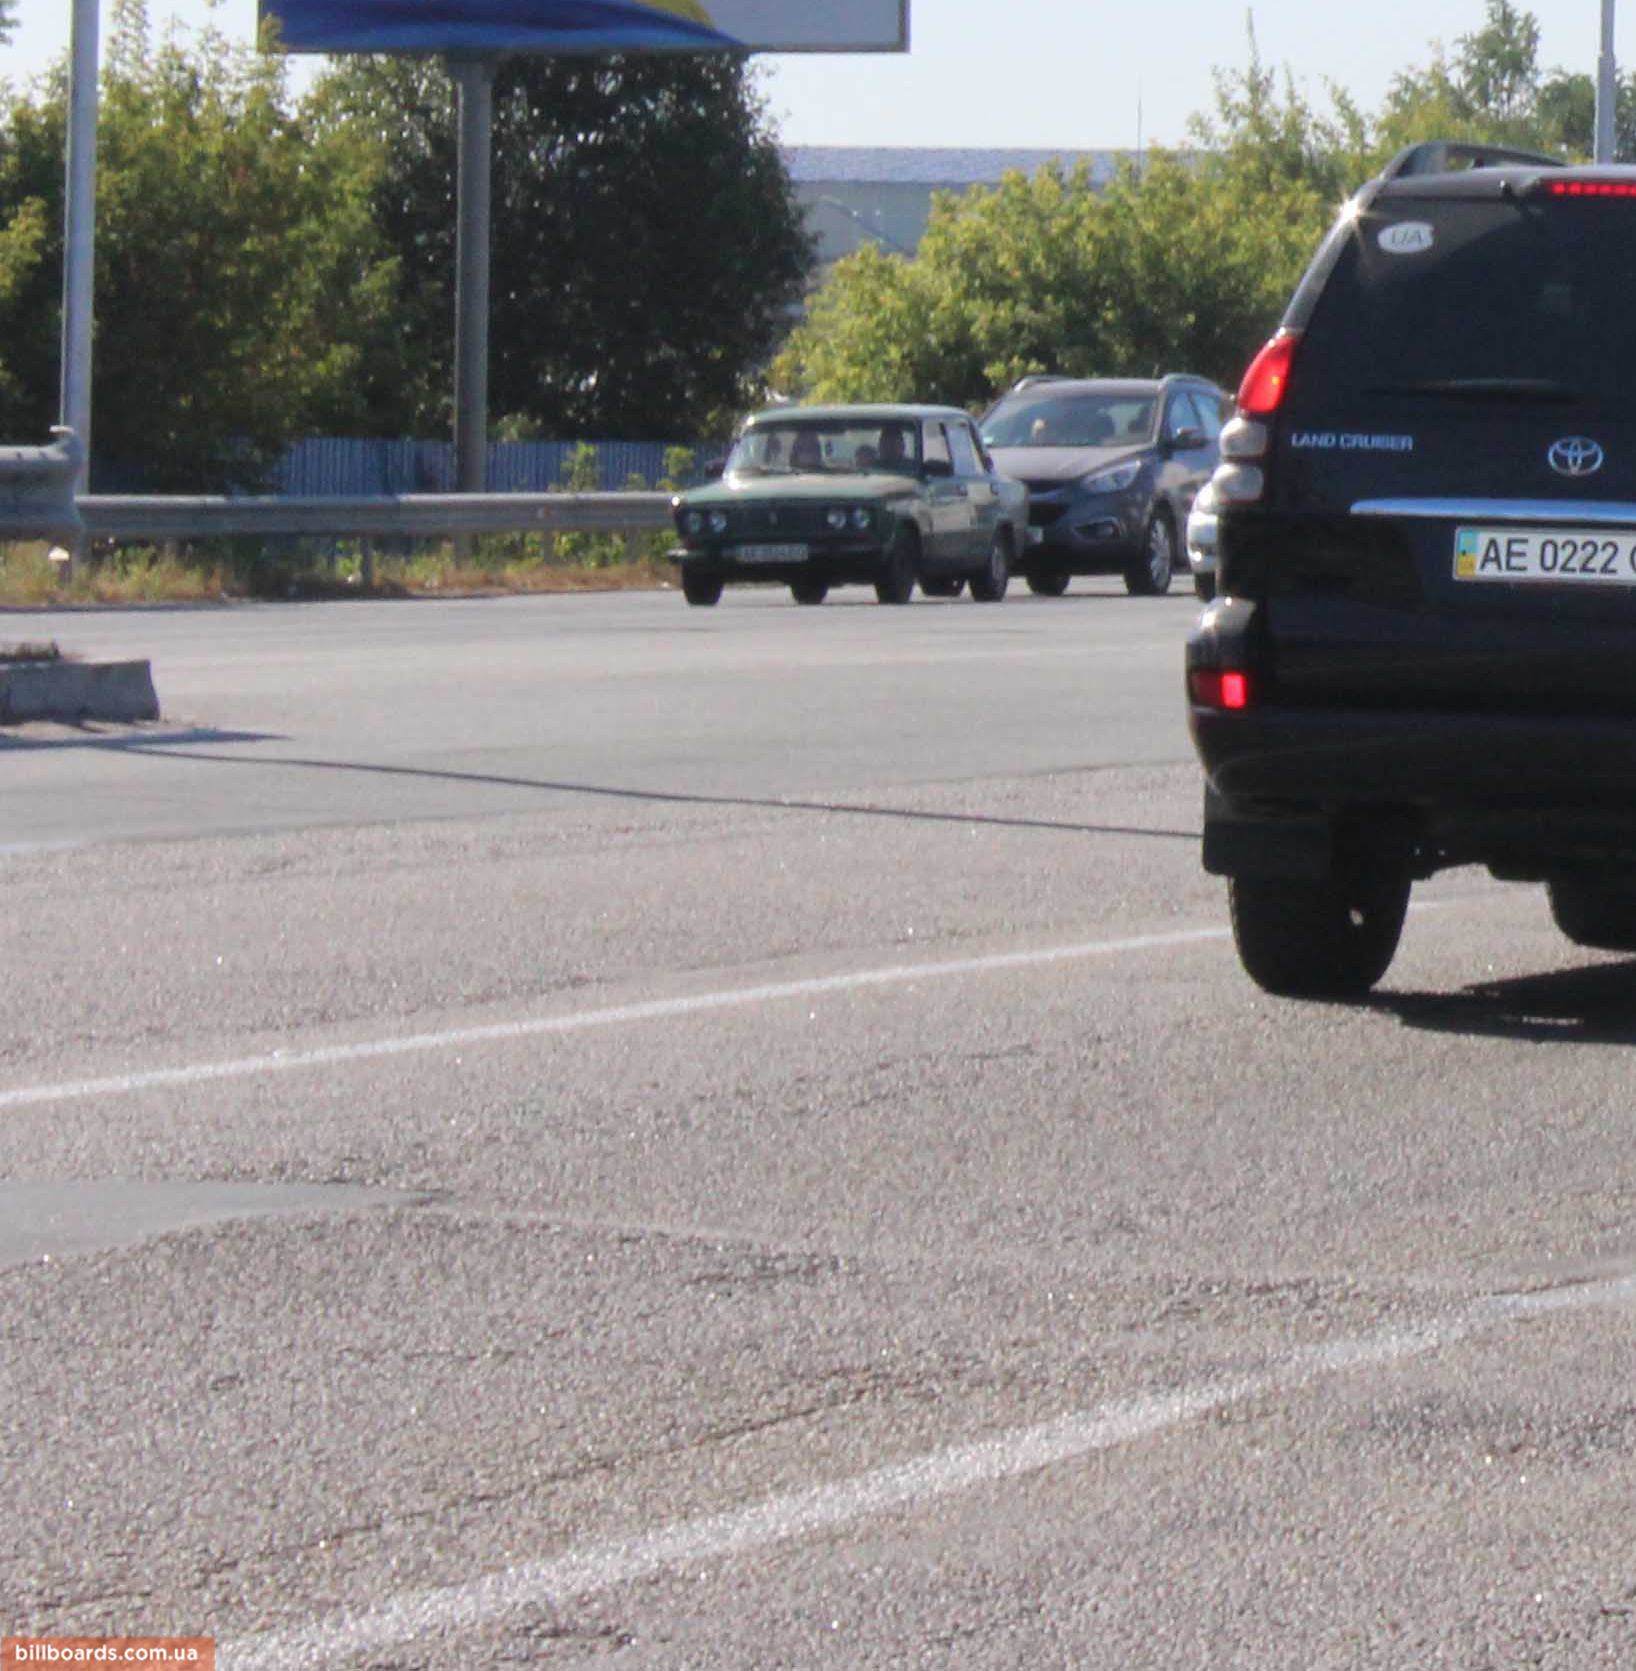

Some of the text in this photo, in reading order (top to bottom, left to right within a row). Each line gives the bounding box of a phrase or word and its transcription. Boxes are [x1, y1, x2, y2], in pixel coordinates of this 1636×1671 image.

[1290, 432, 1336, 448] LAND
[1479, 537, 1529, 572] AE
[1538, 539, 1620, 575] 0222
